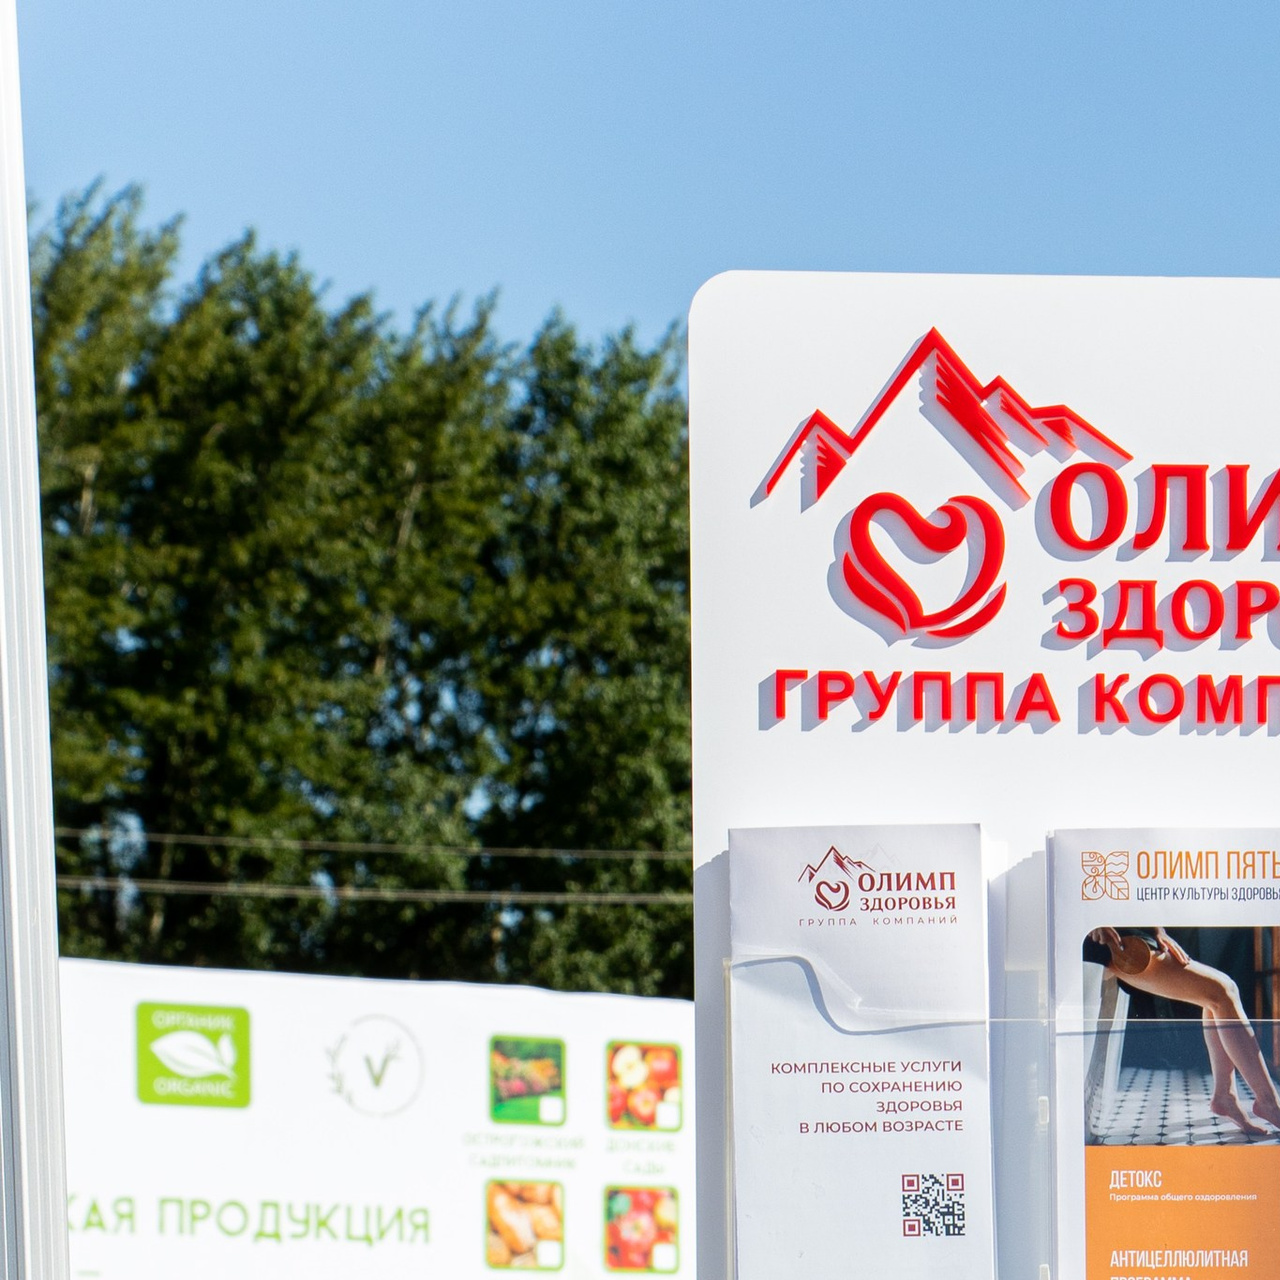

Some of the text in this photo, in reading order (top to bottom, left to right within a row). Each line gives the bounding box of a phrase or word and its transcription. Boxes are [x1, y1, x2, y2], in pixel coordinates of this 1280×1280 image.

[775, 670, 1059, 725] ГРУППА
[1137, 851, 1218, 879] ОЛИМП
[858, 872, 956, 892] ОЛИМП
[1137, 888, 1170, 901] ЦЕНТР
[1173, 887, 1229, 900] КУЛЬТУРЫ
[860, 896, 956, 912] ЗДОРОВЬЯ
[799, 916, 958, 926] ГРУППА КОМПАНИЙ
[771, 1061, 962, 1074] КОМПЛЕКСНЫЕ УСЛУГИ
[154, 1077, 234, 1097] ORGANIC
[822, 1081, 962, 1093] ПО СОХРАНЕНИЮ
[876, 1100, 962, 1114] ЗДОРОВЬЯ
[800, 1120, 963, 1133] В ЛЮБОМ ВОЗРАСТЕ
[1109, 1170, 1162, 1189] ДЕТОКС
[1110, 1193, 1257, 1202] Программа общего оздоровления
[158, 1197, 430, 1247] ПРОДУКЦИЯ
[1110, 1250, 1248, 1269] АНТИЦЕЛЛЮЛИТНАЯ
